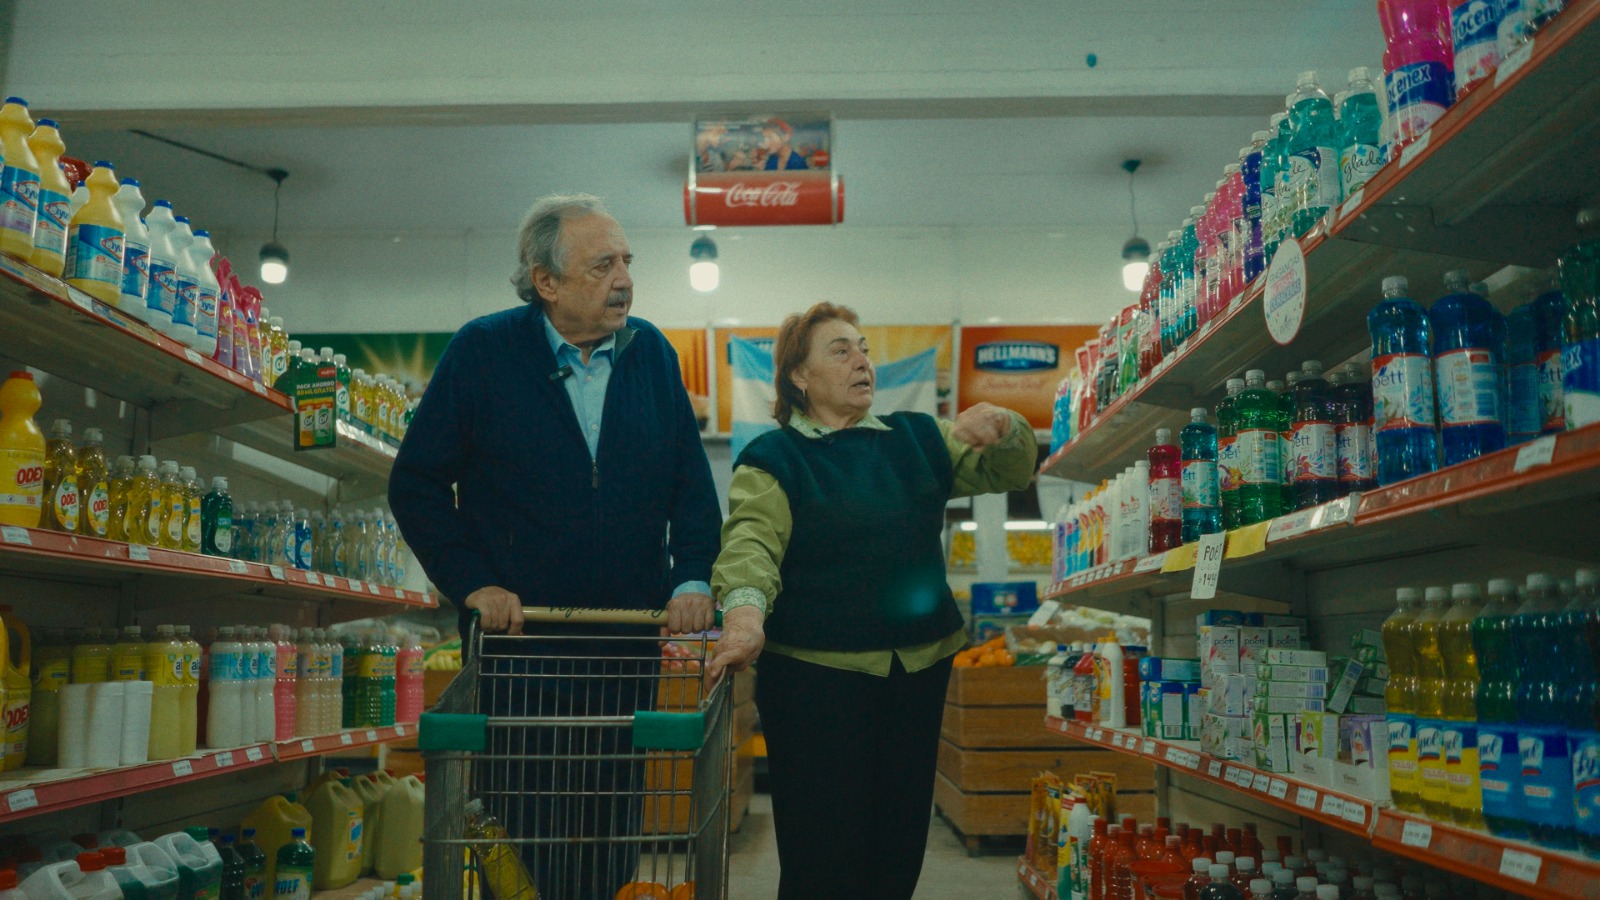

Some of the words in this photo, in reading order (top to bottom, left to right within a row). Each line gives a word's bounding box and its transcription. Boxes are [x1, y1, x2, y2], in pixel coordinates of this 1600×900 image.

[1344, 150, 1382, 184] glade
[725, 182, 801, 208] Coca-Cola
[1374, 370, 1403, 390] oett
[16, 466, 45, 485] ODE
[1183, 470, 1197, 481] ett
[60, 493, 78, 507] ODE
[93, 500, 107, 513] ODE
[1214, 637, 1235, 647] poett
[1244, 637, 1265, 646] poett
